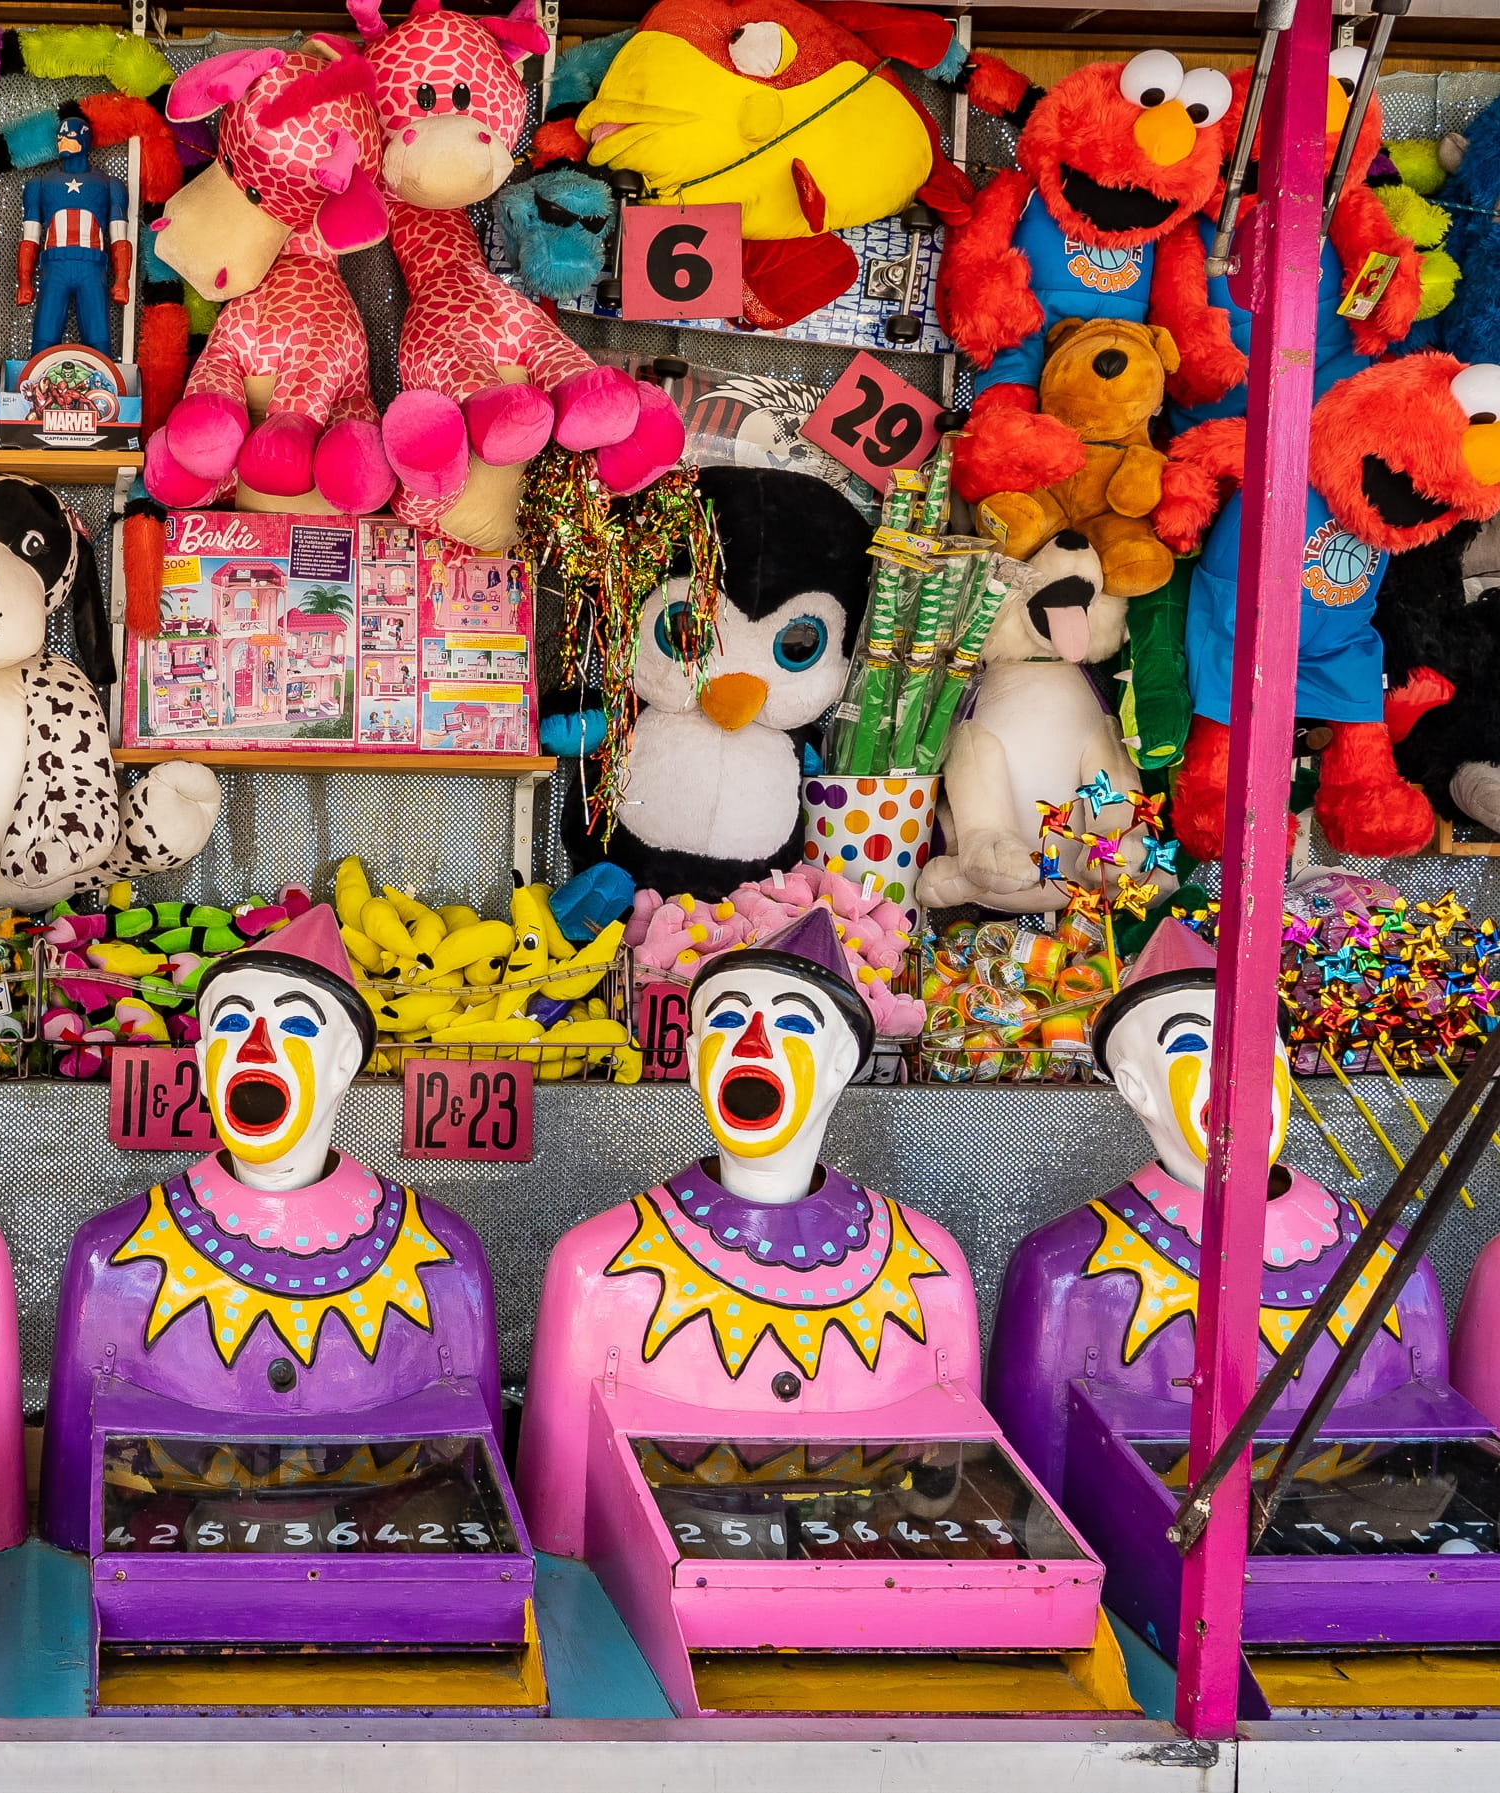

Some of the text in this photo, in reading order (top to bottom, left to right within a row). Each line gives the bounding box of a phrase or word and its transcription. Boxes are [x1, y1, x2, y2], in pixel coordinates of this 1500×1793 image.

[646, 224, 713, 302] 6
[1068, 255, 1141, 292] SCORE!
[45, 412, 94, 431] MARVEL
[831, 374, 923, 467] 29
[178, 514, 260, 553] Barbie
[1302, 566, 1370, 606] SCORE!
[107, 1522, 490, 1545] 4 2 5 1 3 6 4 2 3
[675, 1519, 1013, 1545] 2 5 1 3 6 4 2 3
